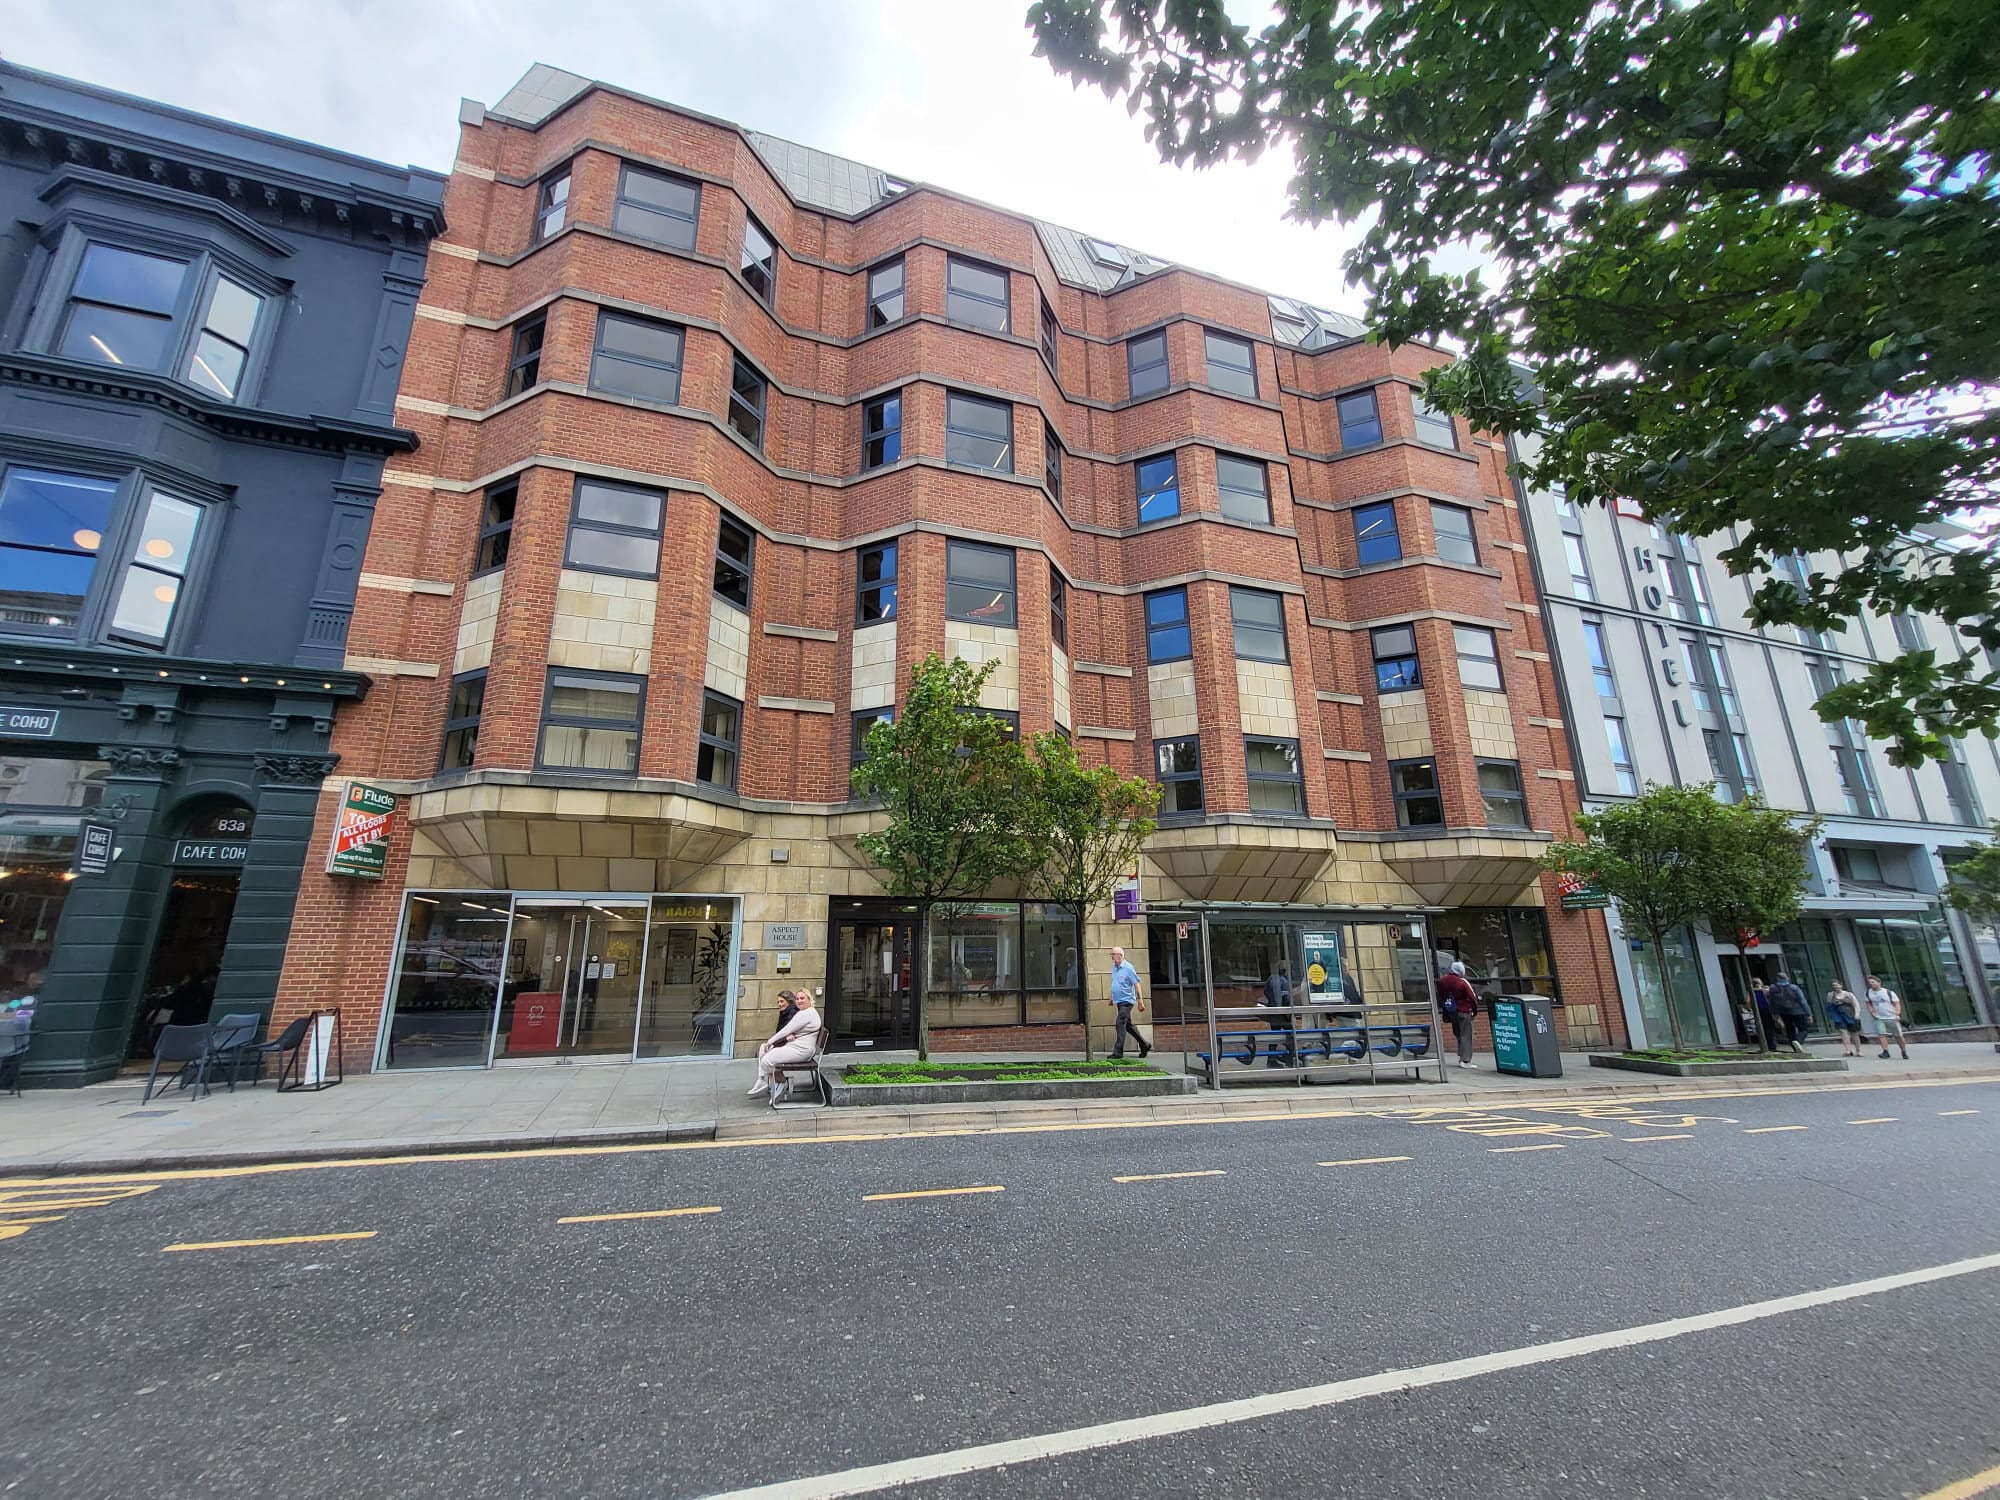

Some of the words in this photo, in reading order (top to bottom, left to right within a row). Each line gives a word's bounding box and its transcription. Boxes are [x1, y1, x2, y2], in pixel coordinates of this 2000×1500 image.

[1633, 546, 1692, 728] HOTEL
[10, 714, 49, 729] COHO
[364, 789, 395, 806] Flude
[218, 819, 246, 832] 83a
[349, 812, 367, 825] TO
[343, 827, 359, 838] ALL
[360, 815, 387, 831] FLOORS
[90, 831, 108, 845] CAFE
[350, 832, 369, 849] LET
[371, 827, 383, 840] BY
[182, 845, 217, 859] CAFE
[220, 846, 247, 860] COH
